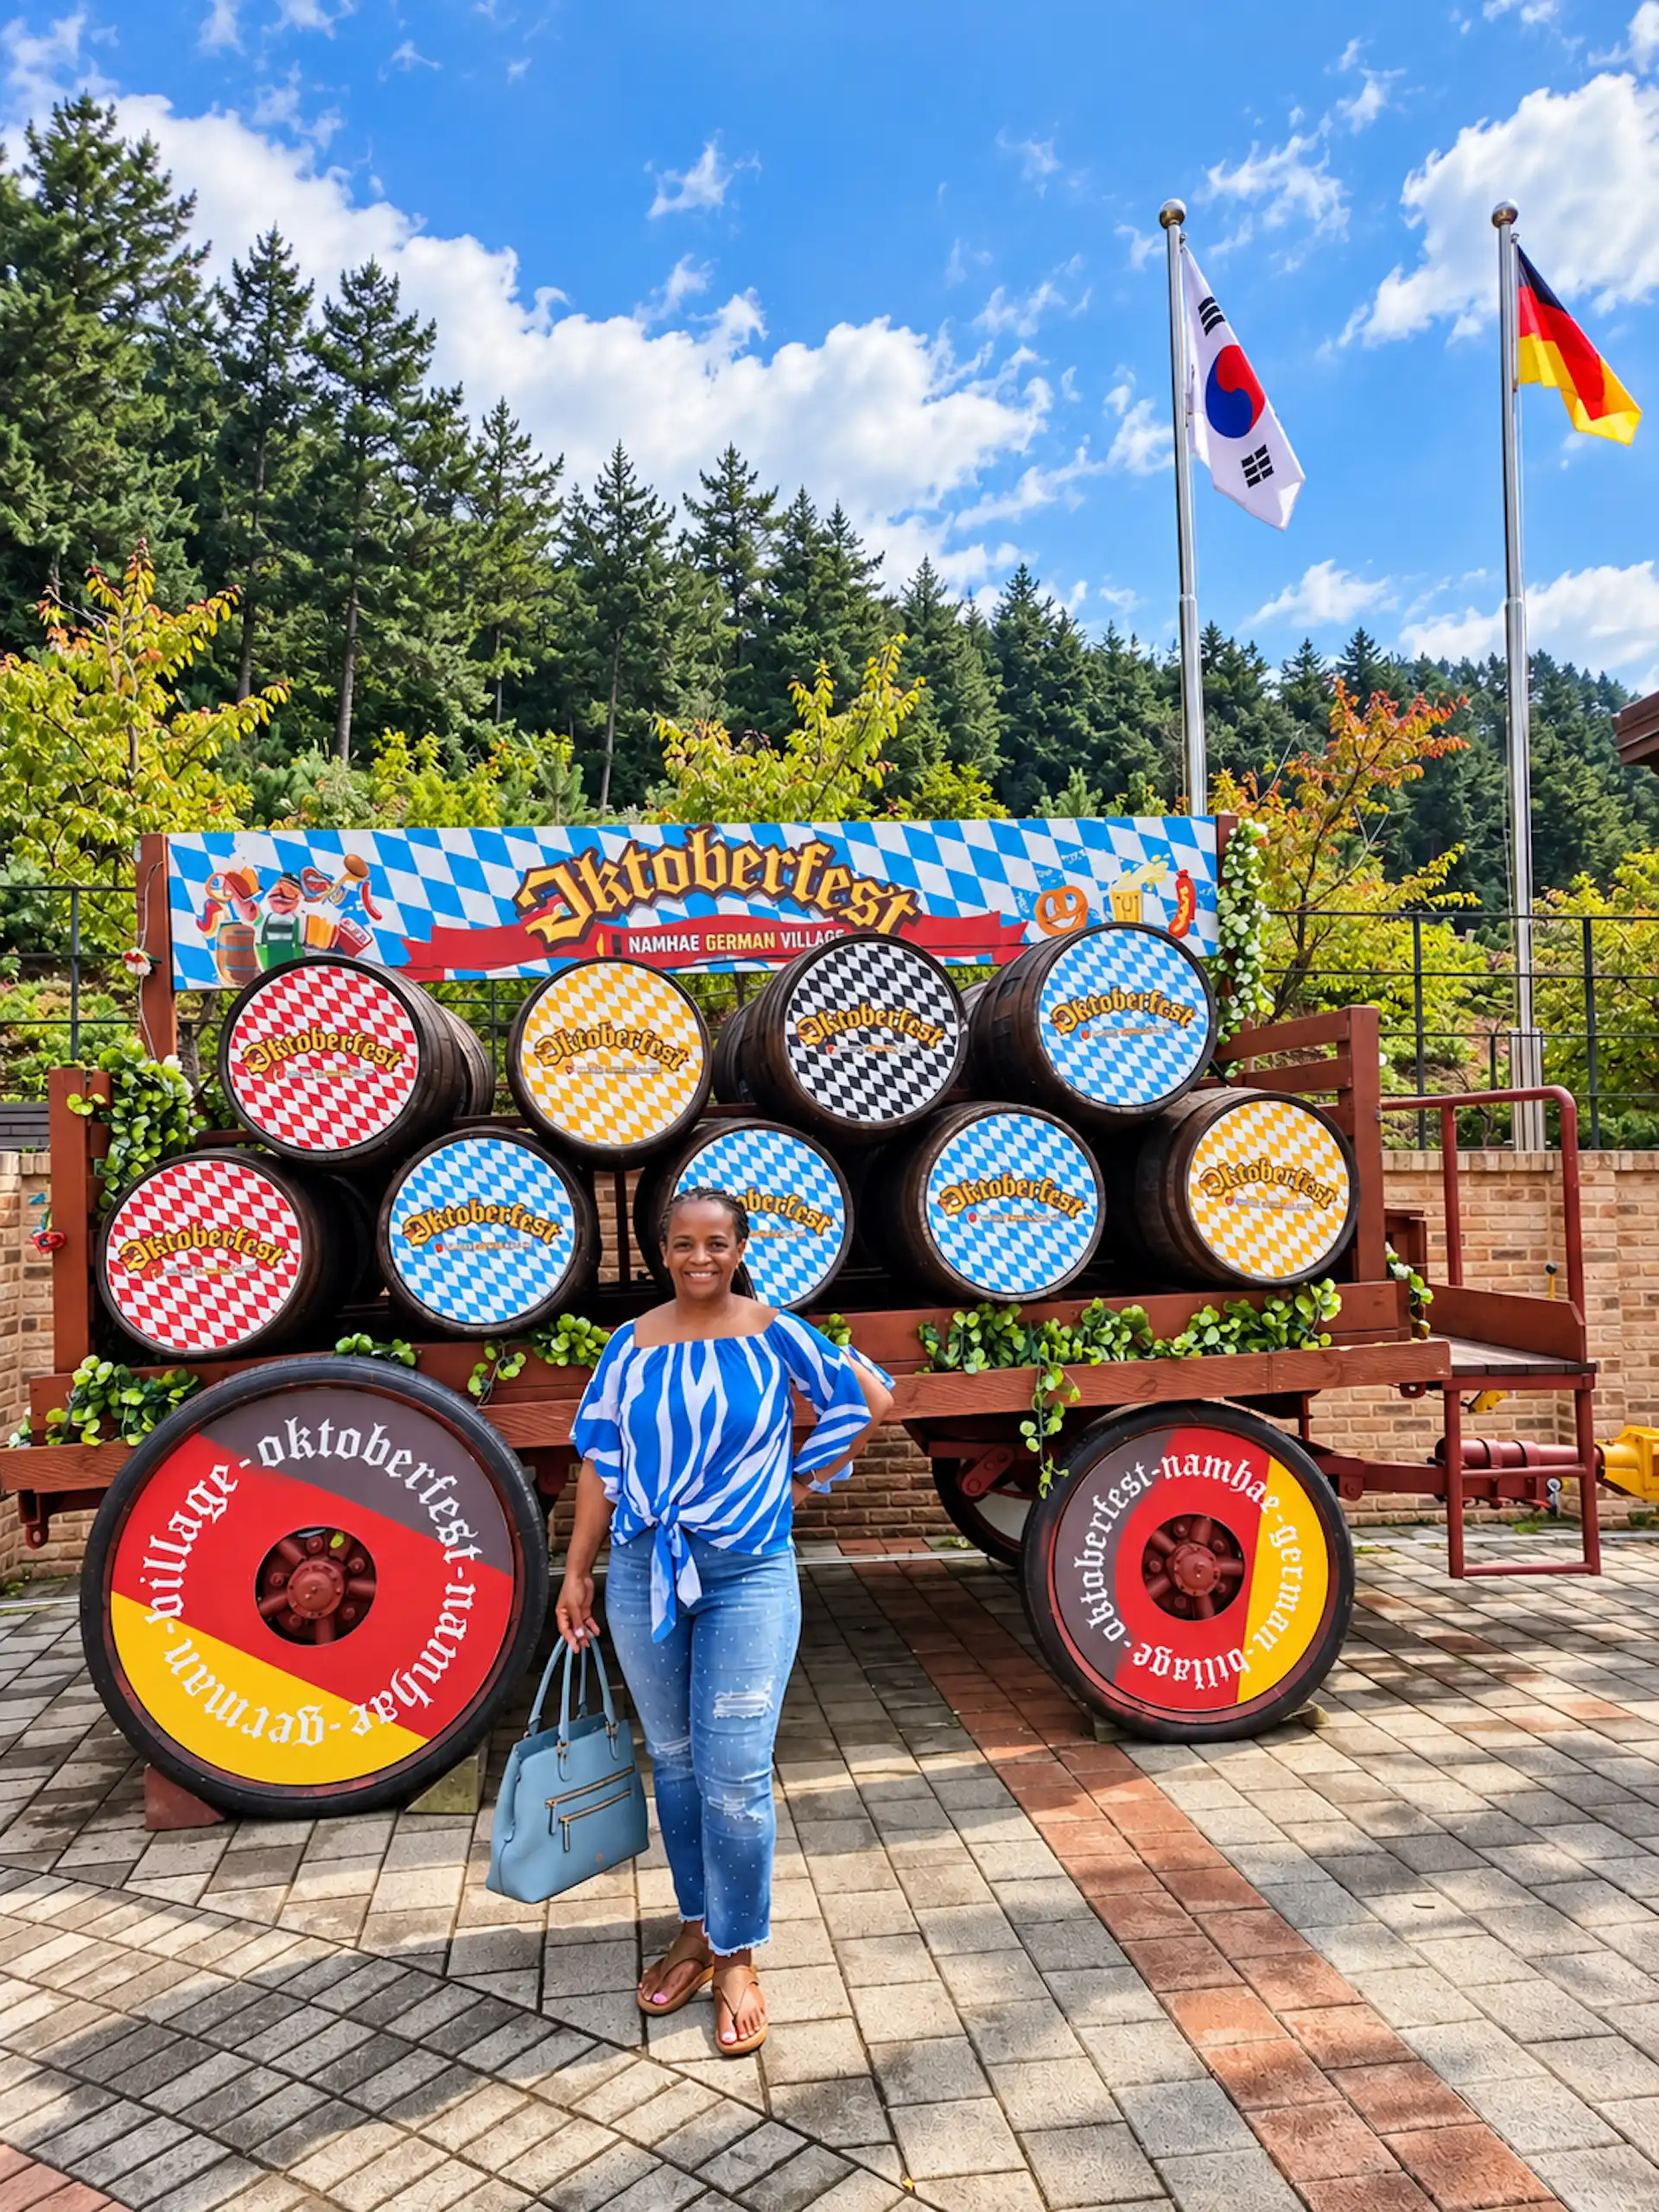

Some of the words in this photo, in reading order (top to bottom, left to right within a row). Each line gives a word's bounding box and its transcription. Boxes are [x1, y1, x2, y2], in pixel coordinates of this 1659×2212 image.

[628, 934, 701, 954] NAMHAE
[705, 931, 776, 950] GERMAN
[735, 1187, 832, 1236] berfest
